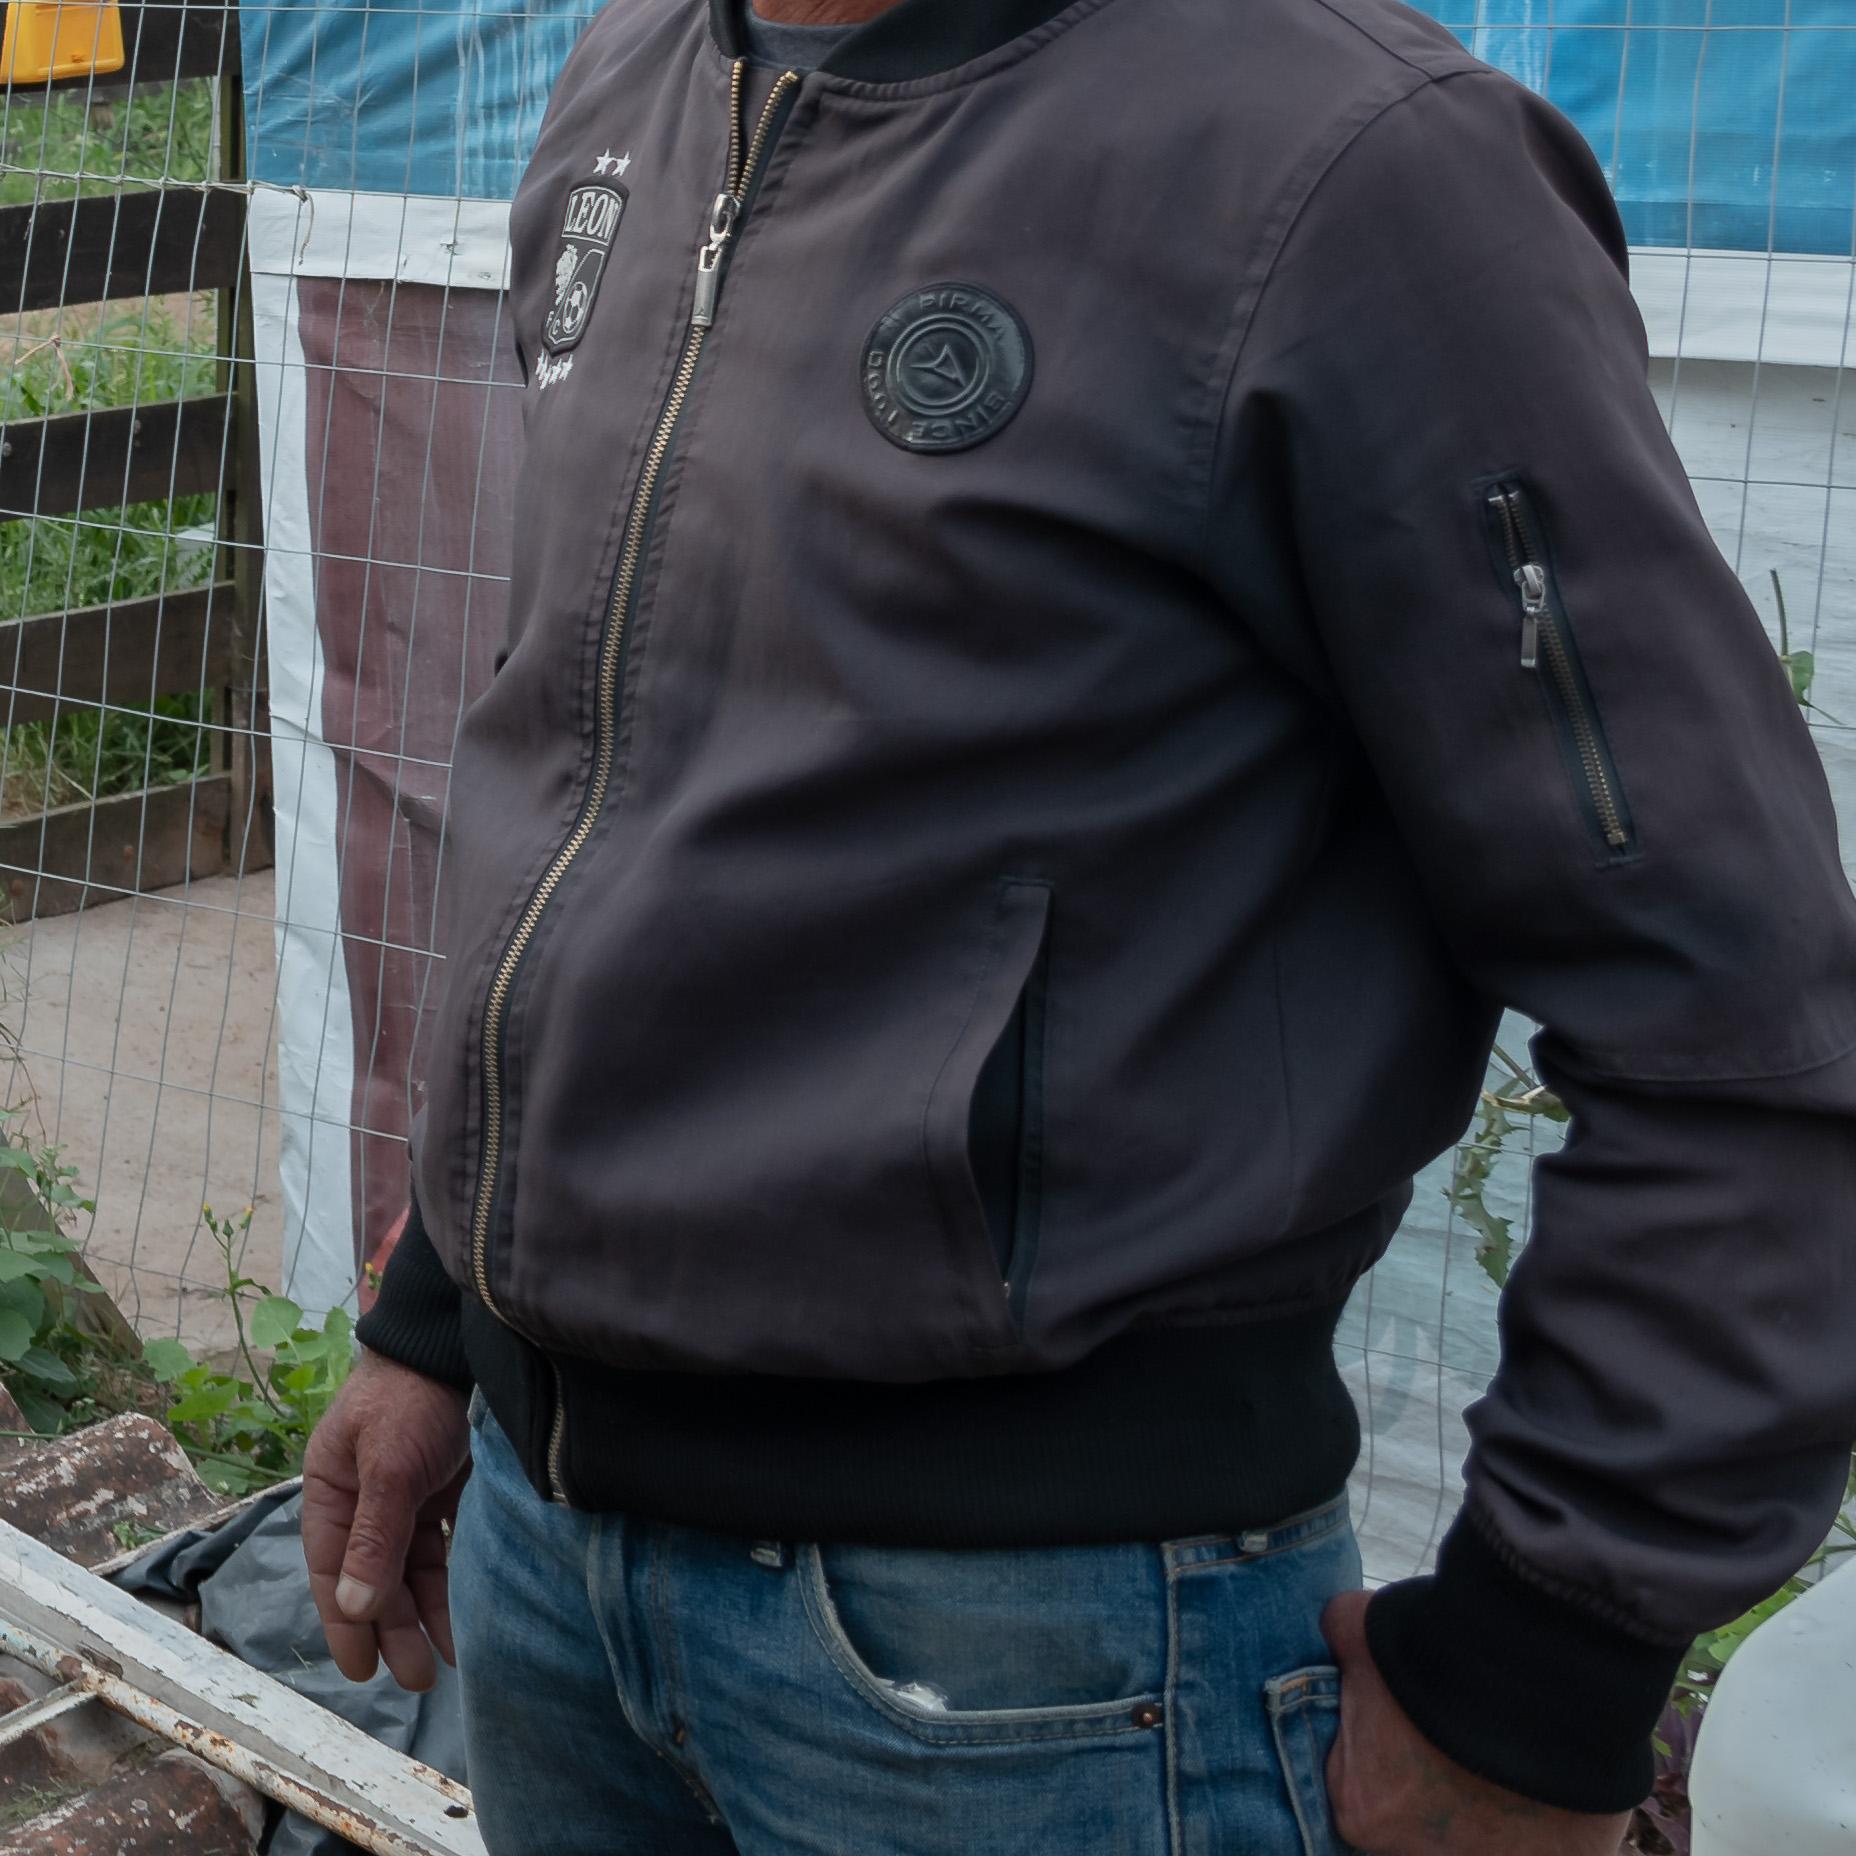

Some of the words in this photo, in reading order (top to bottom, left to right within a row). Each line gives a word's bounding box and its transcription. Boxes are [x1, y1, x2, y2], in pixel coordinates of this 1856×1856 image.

[566, 192, 618, 239] LEON
[919, 293, 1007, 343] PIRMA
[911, 392, 1012, 439] SINCE
